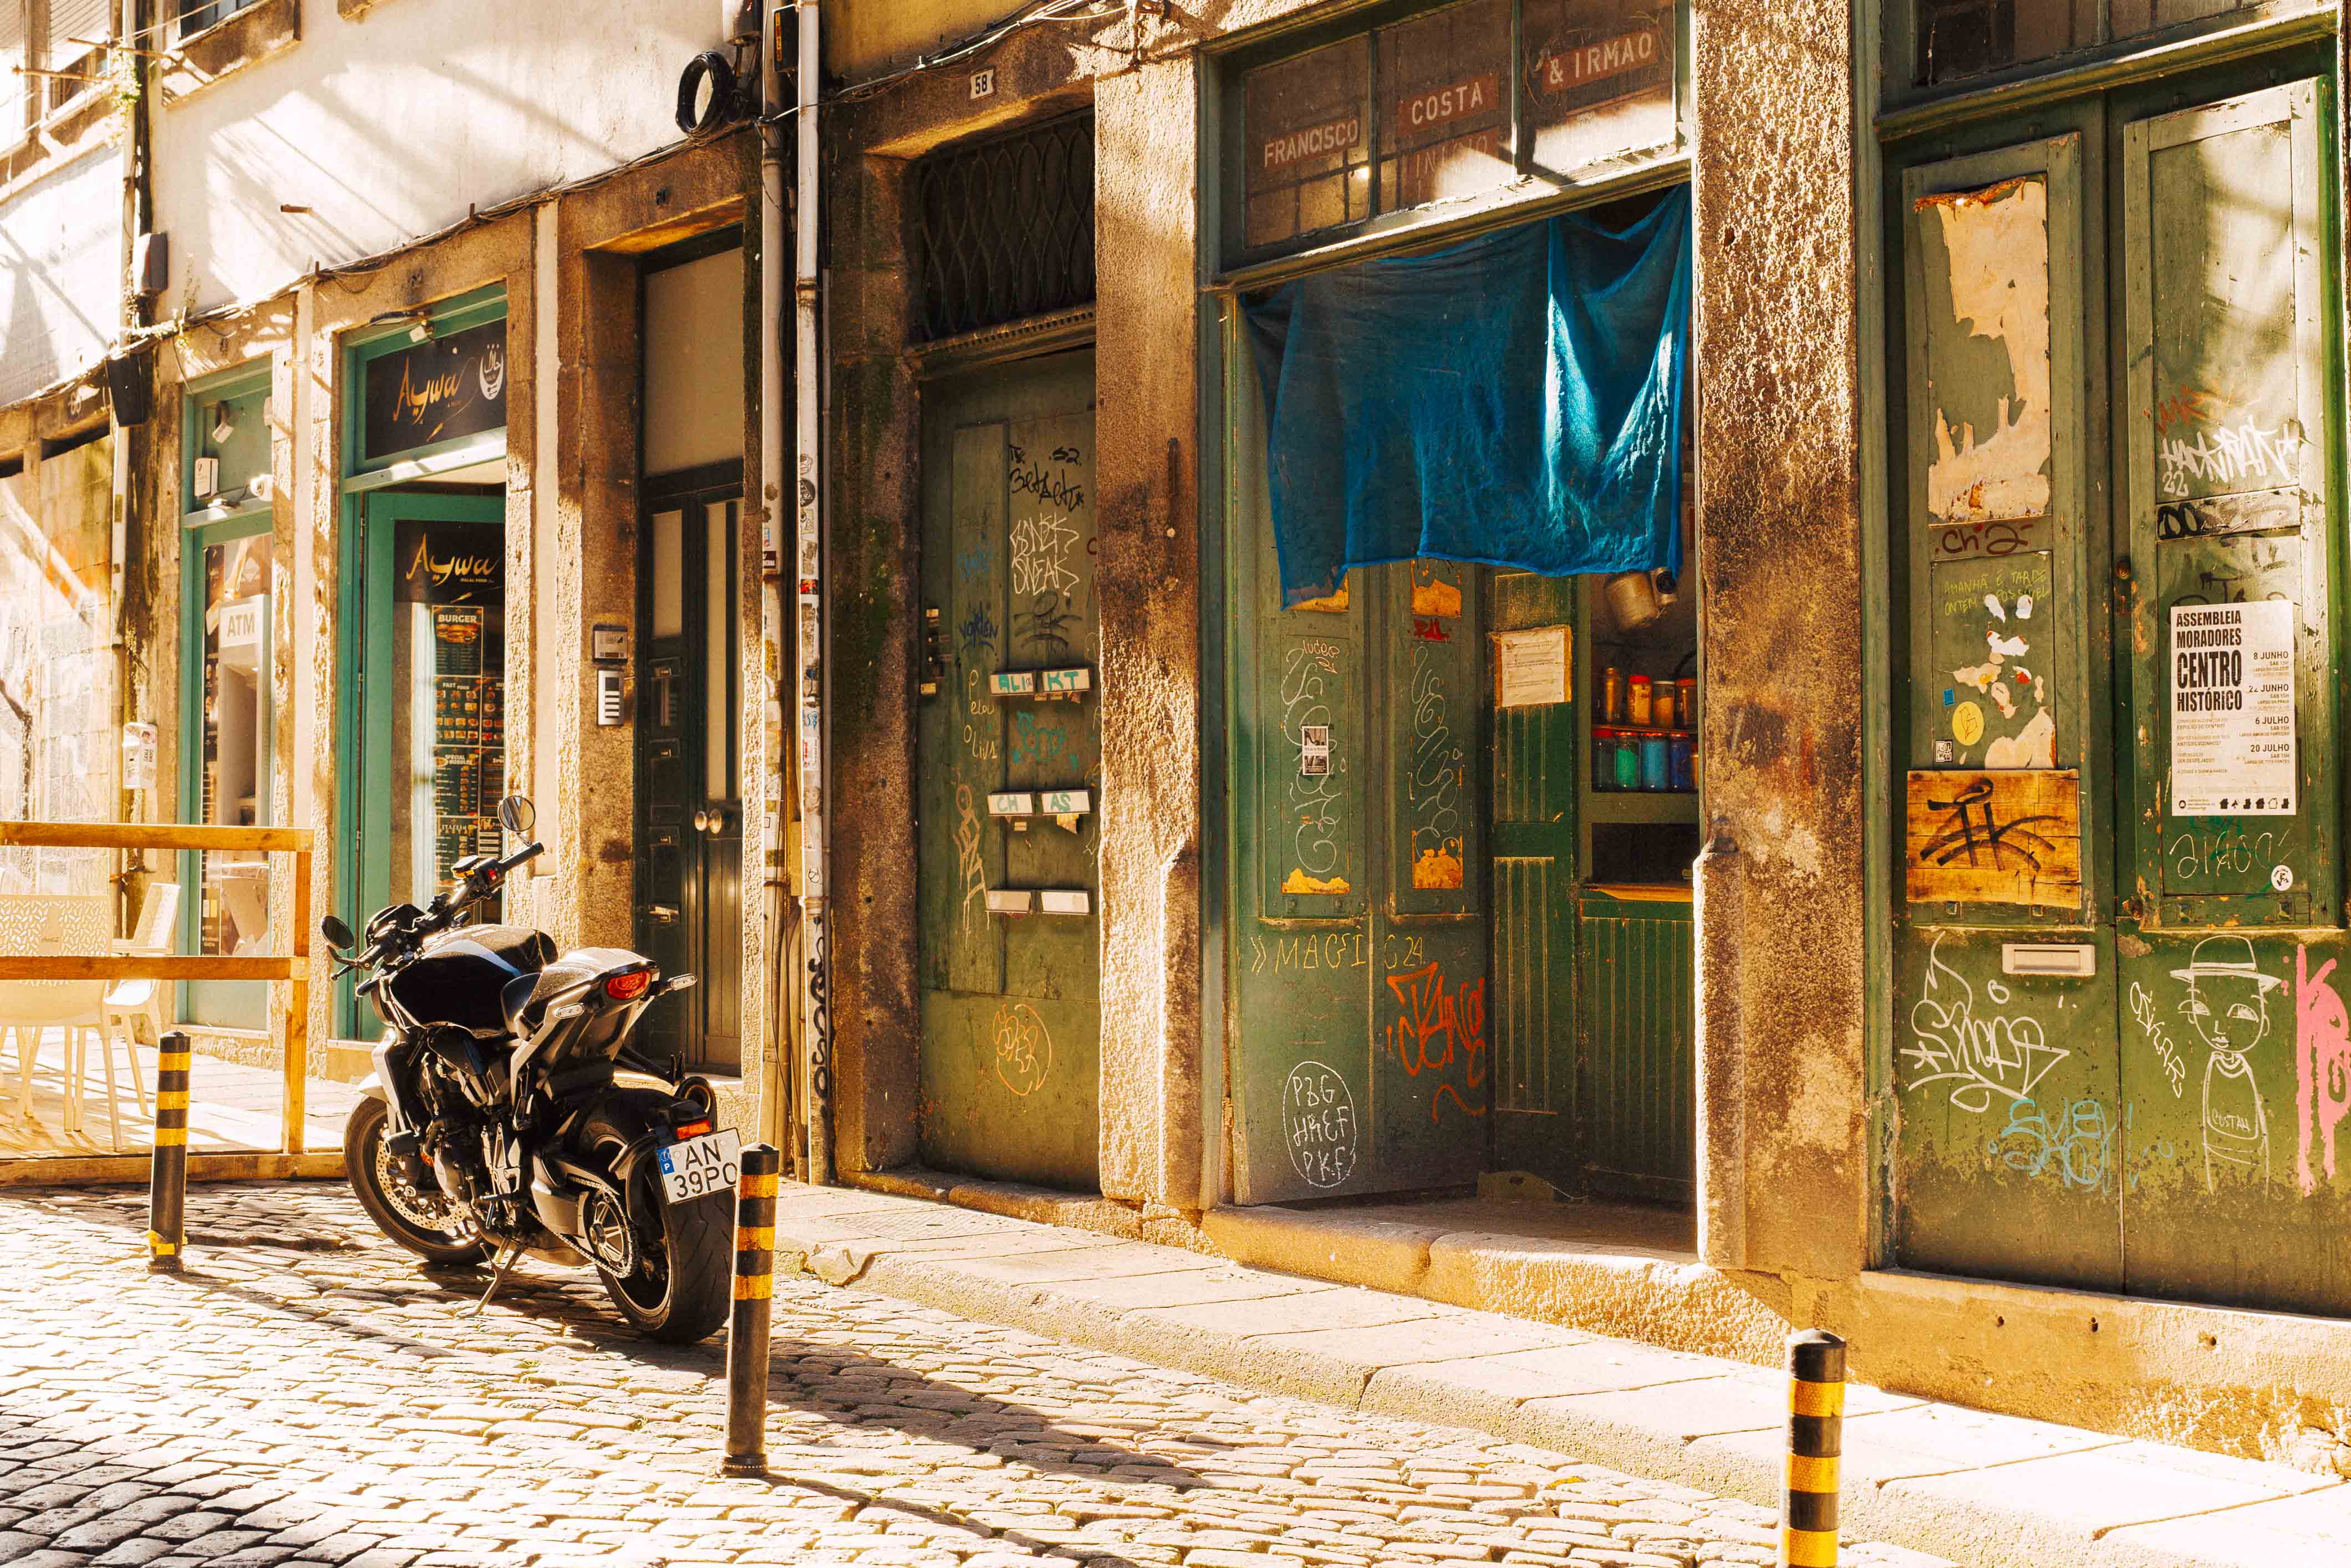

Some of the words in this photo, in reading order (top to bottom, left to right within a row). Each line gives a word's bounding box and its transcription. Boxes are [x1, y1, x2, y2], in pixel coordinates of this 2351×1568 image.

[975, 74, 987, 94] 58
[1264, 119, 1358, 168] FRANCISCO
[1411, 82, 1483, 125] COSTA
[1549, 59, 1564, 85] &
[392, 356, 461, 425] Aywa
[405, 532, 497, 588] Aywa
[227, 612, 256, 637] ATM
[437, 614, 477, 623] BURGER
[2176, 610, 2242, 628] ASSEMBLEIA
[2176, 628, 2242, 649] MORADORES
[2261, 651, 2289, 660] JUNHO
[2177, 650, 2242, 689] CENTRO
[2261, 684, 2289, 693] JUNHO
[2177, 688, 2242, 712] HISTÓRICO
[2262, 716, 2289, 725] JULHO
[2262, 744, 2289, 752] JULHO
[685, 1138, 721, 1170] AN
[664, 1163, 671, 1171] P
